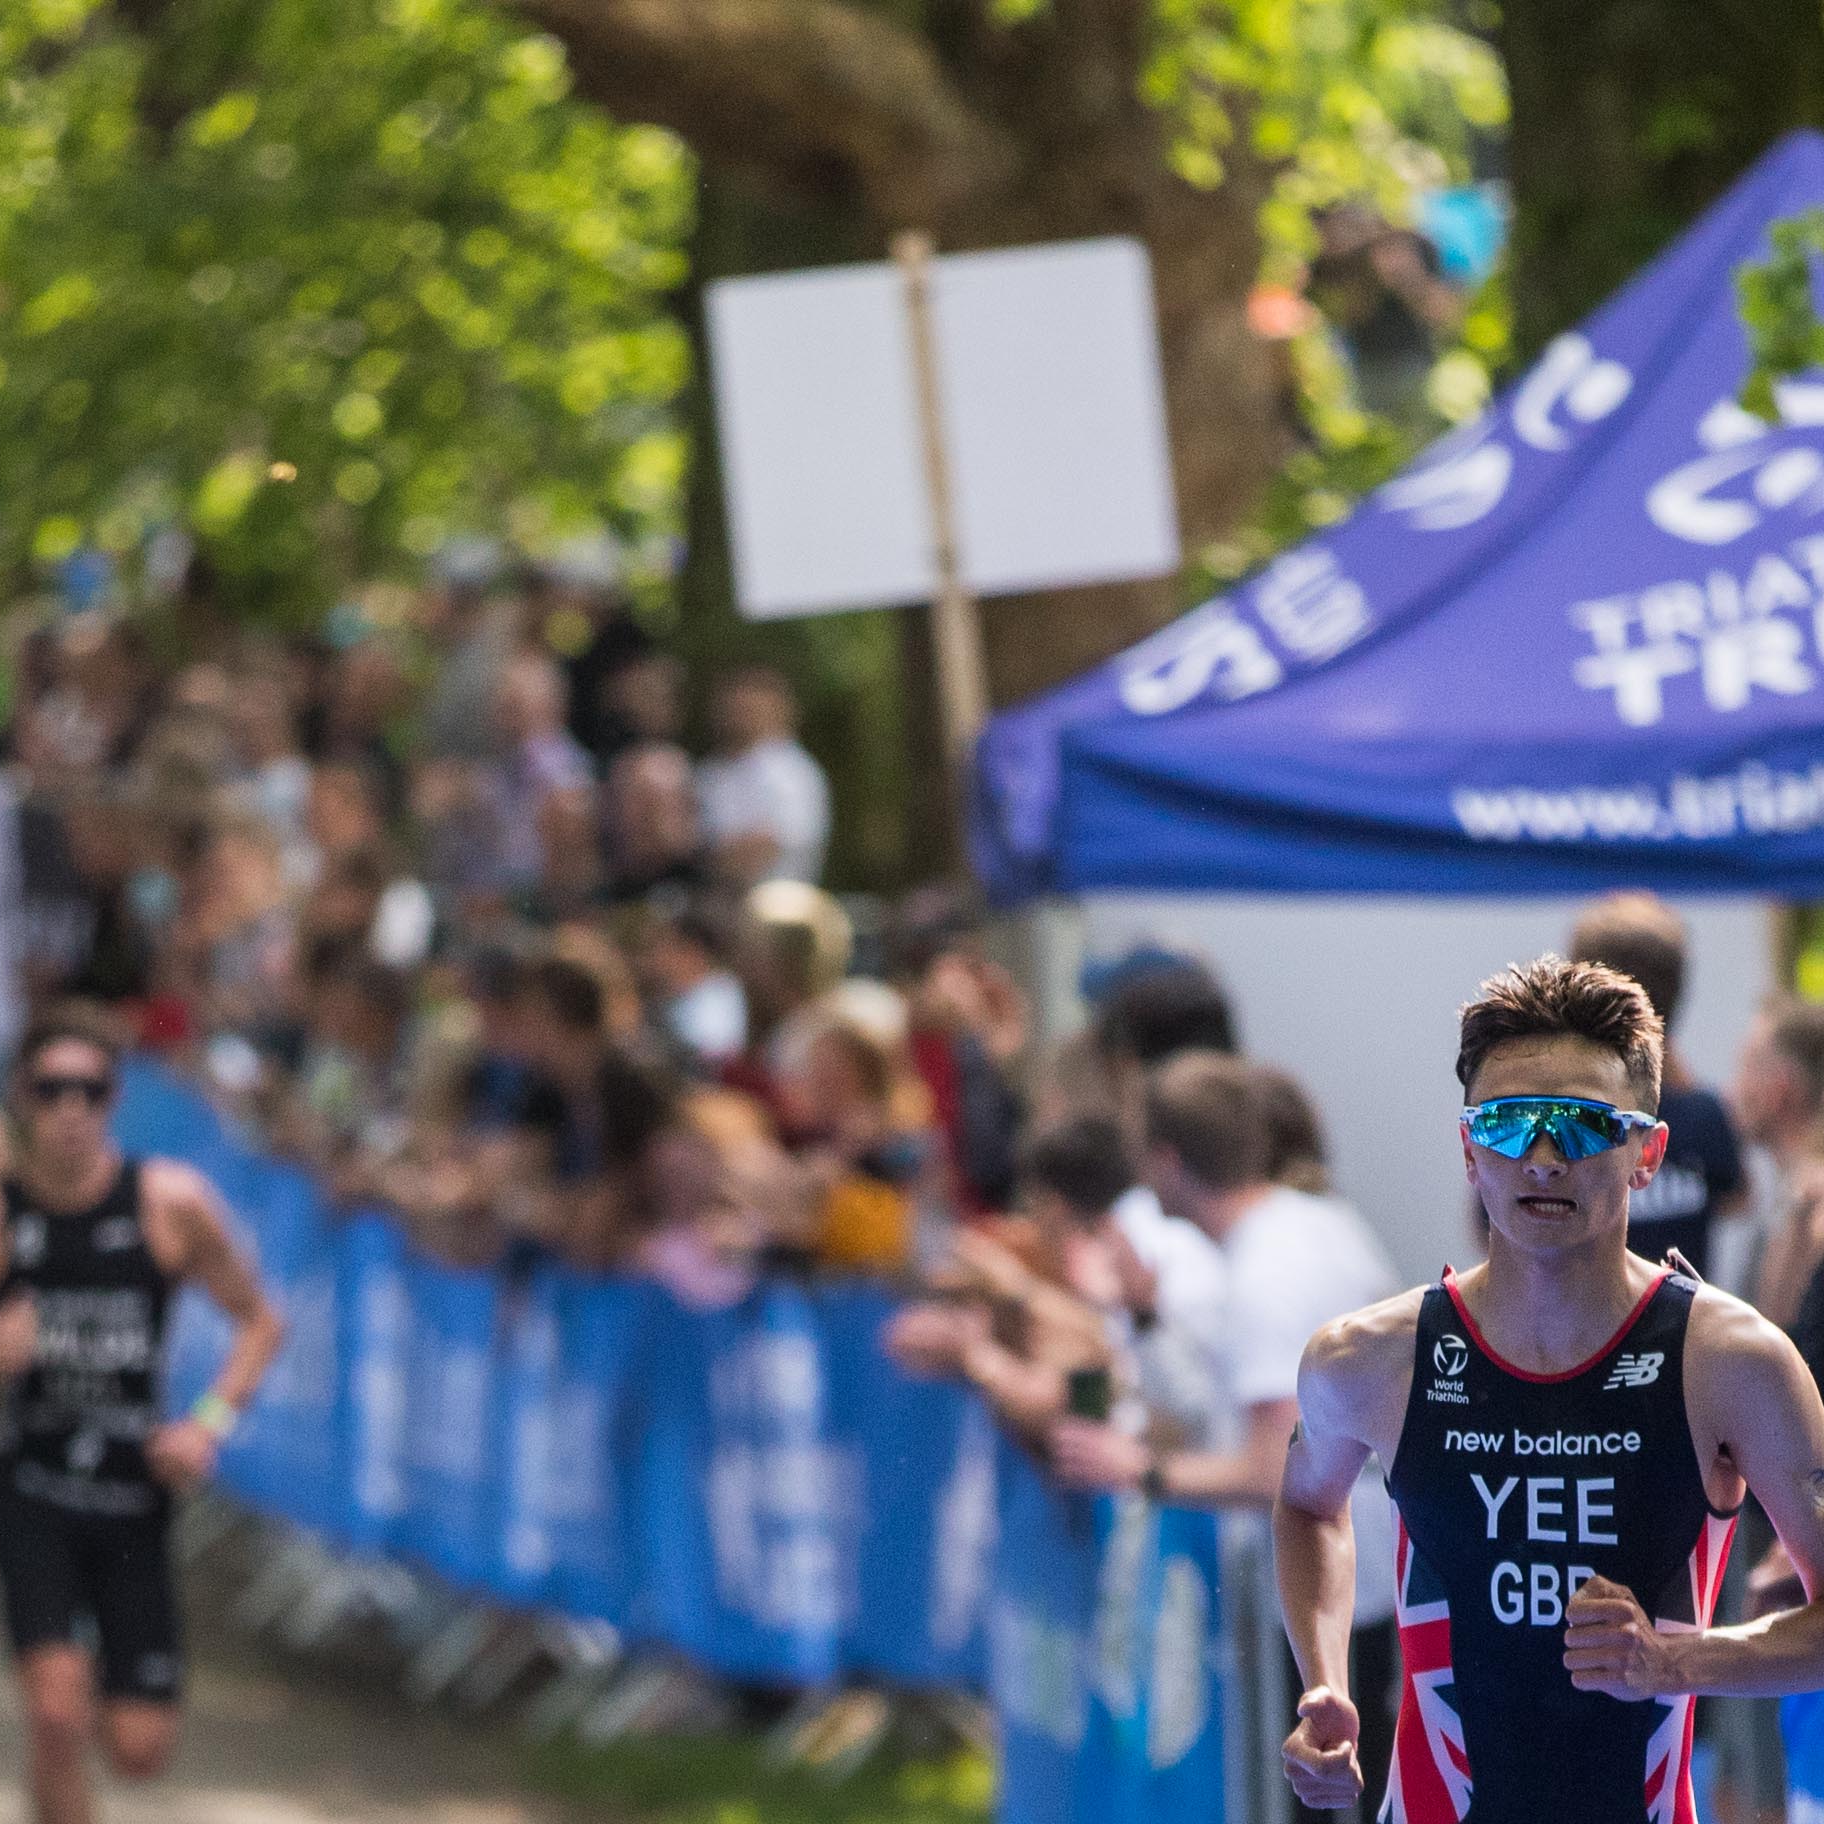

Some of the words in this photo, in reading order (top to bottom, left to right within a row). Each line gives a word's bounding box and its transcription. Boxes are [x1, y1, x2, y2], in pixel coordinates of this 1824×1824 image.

[1434, 1379, 1464, 1392] World
[1426, 1390, 1470, 1405] Triathlon
[1445, 1430, 1505, 1453] new
[1514, 1429, 1642, 1456] balance
[1469, 1473, 1619, 1545] YEE
